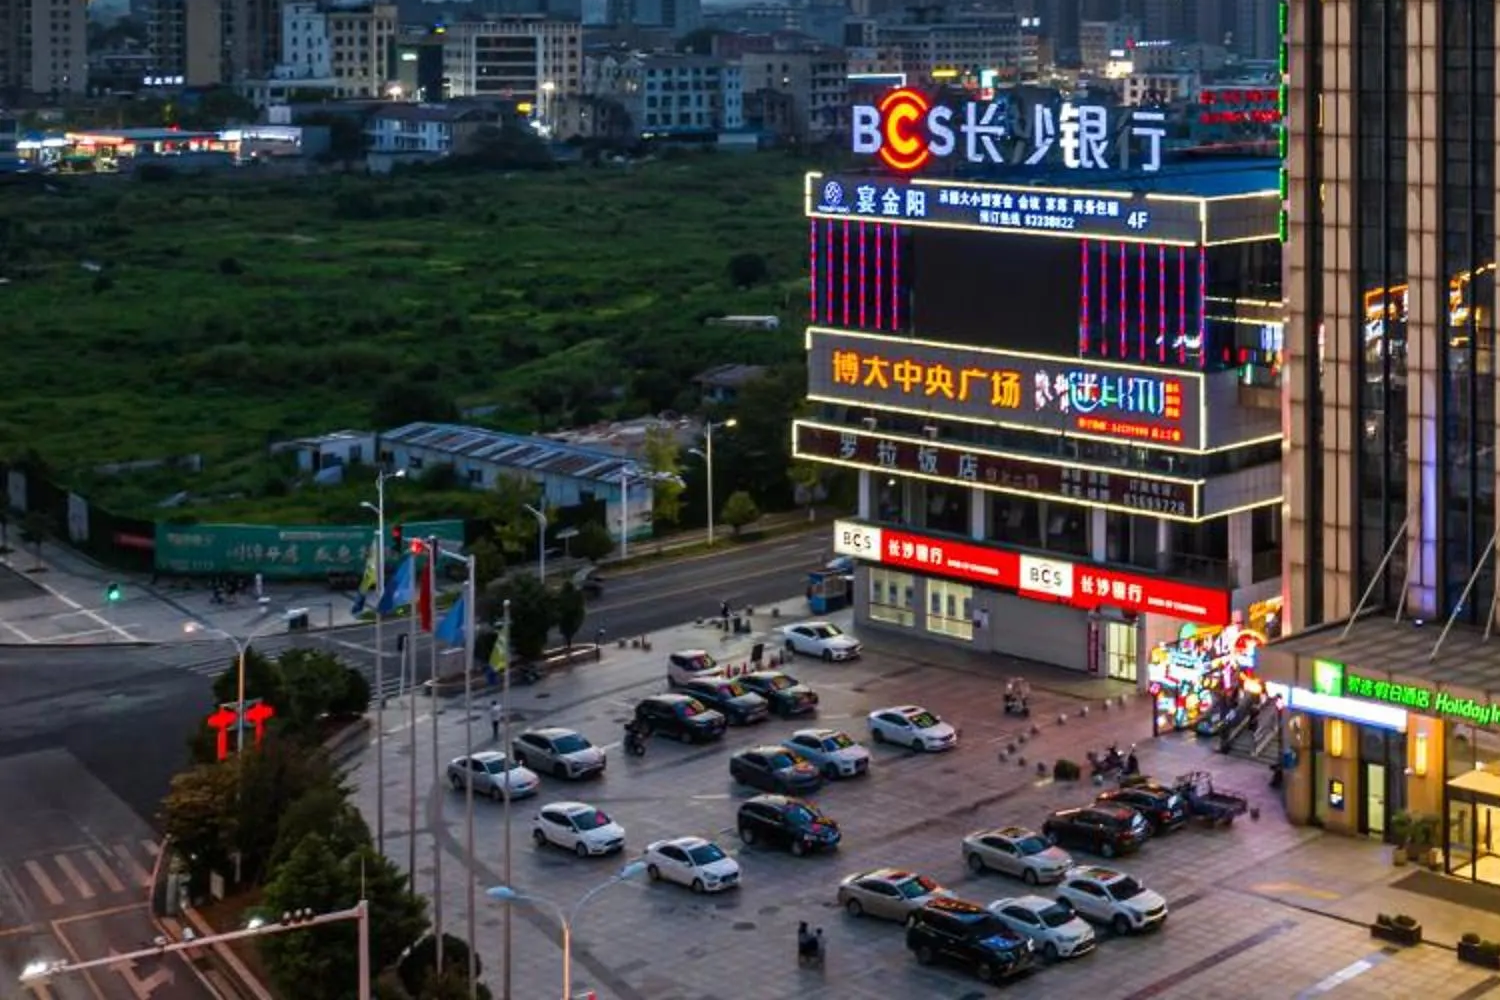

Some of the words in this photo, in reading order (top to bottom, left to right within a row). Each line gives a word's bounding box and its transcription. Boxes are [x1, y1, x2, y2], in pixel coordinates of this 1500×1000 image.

[853, 103, 955, 157] BCS
[857, 185, 925, 217] 宴金阳
[1127, 211, 1148, 229] 4F
[832, 350, 1022, 409] 博大中央广场
[843, 531, 872, 550] BCS
[1029, 567, 1063, 587] BCS
[1080, 574, 1144, 603] 长沙银行
[1436, 693, 1490, 726] Holiday
